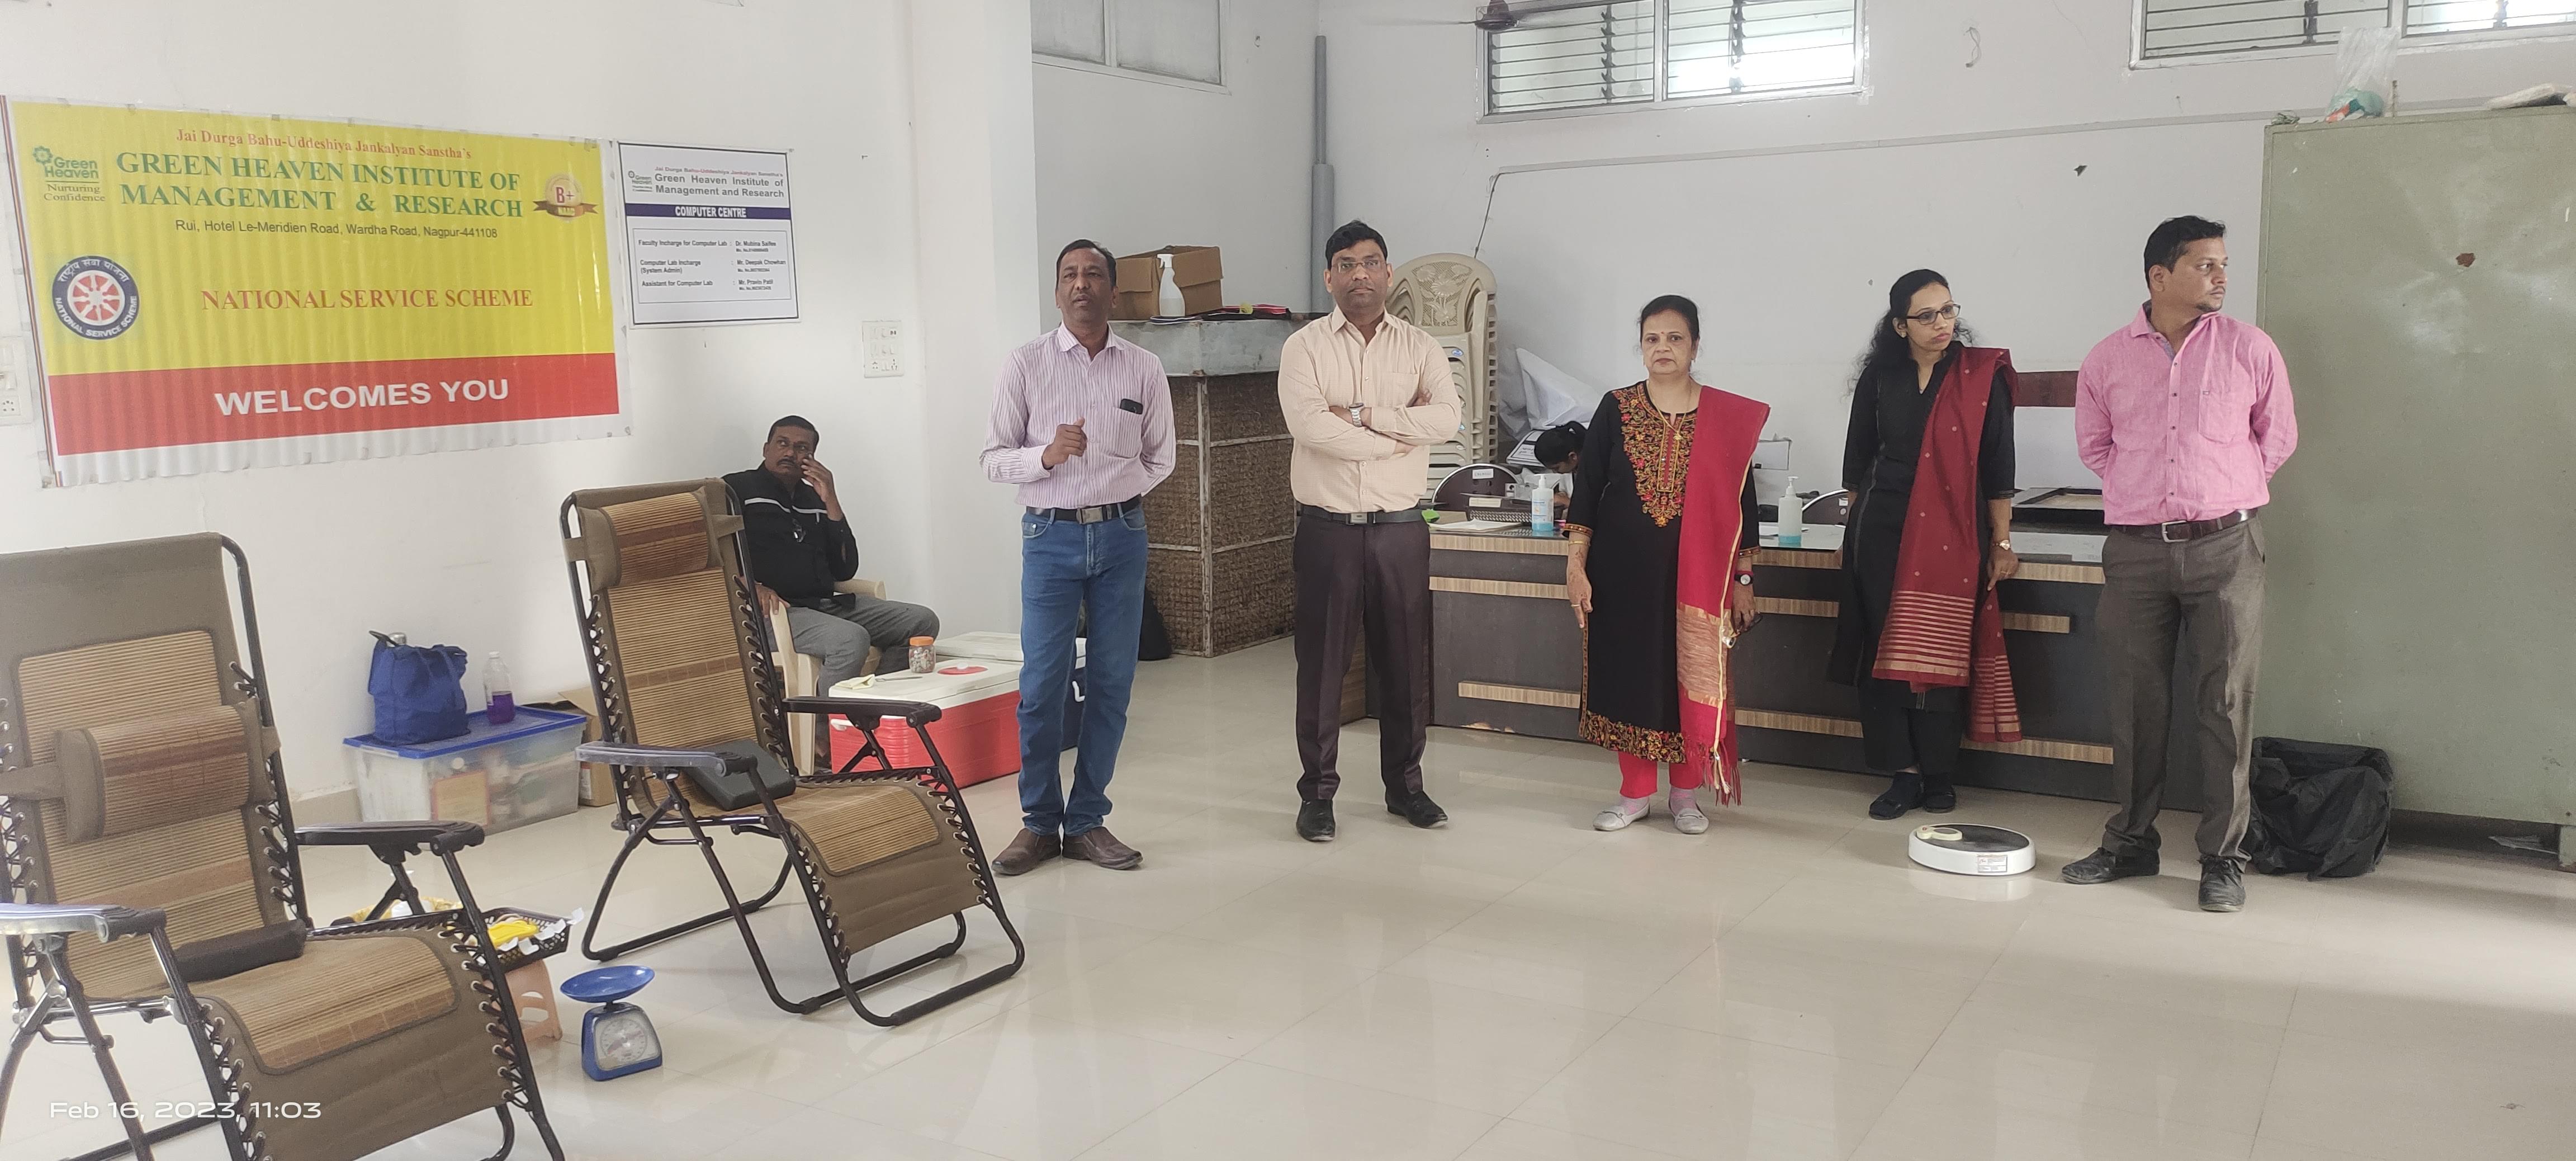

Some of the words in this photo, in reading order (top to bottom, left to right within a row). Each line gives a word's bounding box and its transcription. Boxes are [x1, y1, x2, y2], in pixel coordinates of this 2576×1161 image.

[177, 129, 196, 143] Jai
[201, 130, 243, 147] Durga
[247, 133, 352, 153] Bahu-Uddeshiya
[356, 140, 416, 157] Jankalyan
[54, 157, 98, 169] Green
[116, 152, 222, 176] GREEN
[232, 157, 344, 182] HEAVEN
[351, 163, 484, 189] INSTITUTE
[490, 172, 520, 191] OF
[45, 166, 98, 178] Heaven
[655, 173, 685, 183] Green
[691, 174, 727, 185] Heaven
[732, 177, 769, 186] Institute
[774, 178, 784, 187] of
[44, 193, 106, 201] Confidence
[48, 184, 100, 194] Nurturing
[555, 187, 575, 204] B+
[655, 185, 720, 196] Management
[722, 187, 739, 196] and
[742, 188, 784, 197] Research
[120, 183, 336, 210] MANAGEMENT
[356, 192, 376, 212] &
[392, 194, 523, 218] RESEARCH
[675, 206, 717, 217] COMPUTER
[718, 206, 747, 218] CENTRE
[176, 219, 200, 233] Rui,
[205, 220, 235, 232] Hotel
[239, 221, 307, 233] Le-Meridien
[310, 222, 343, 235] Road,
[346, 224, 388, 235] Wardha
[390, 225, 420, 238] Road,
[423, 226, 498, 239] Nagpur-441108
[201, 290, 335, 310] NATIONAL
[340, 289, 438, 308] SERVICE
[446, 289, 534, 307] SCHEME
[55, 297, 84, 334] NATIONAL
[86, 325, 122, 338] SERVICE
[121, 296, 137, 328] SCHEME
[215, 382, 432, 416] WELCOMES
[439, 379, 509, 403] YOU
